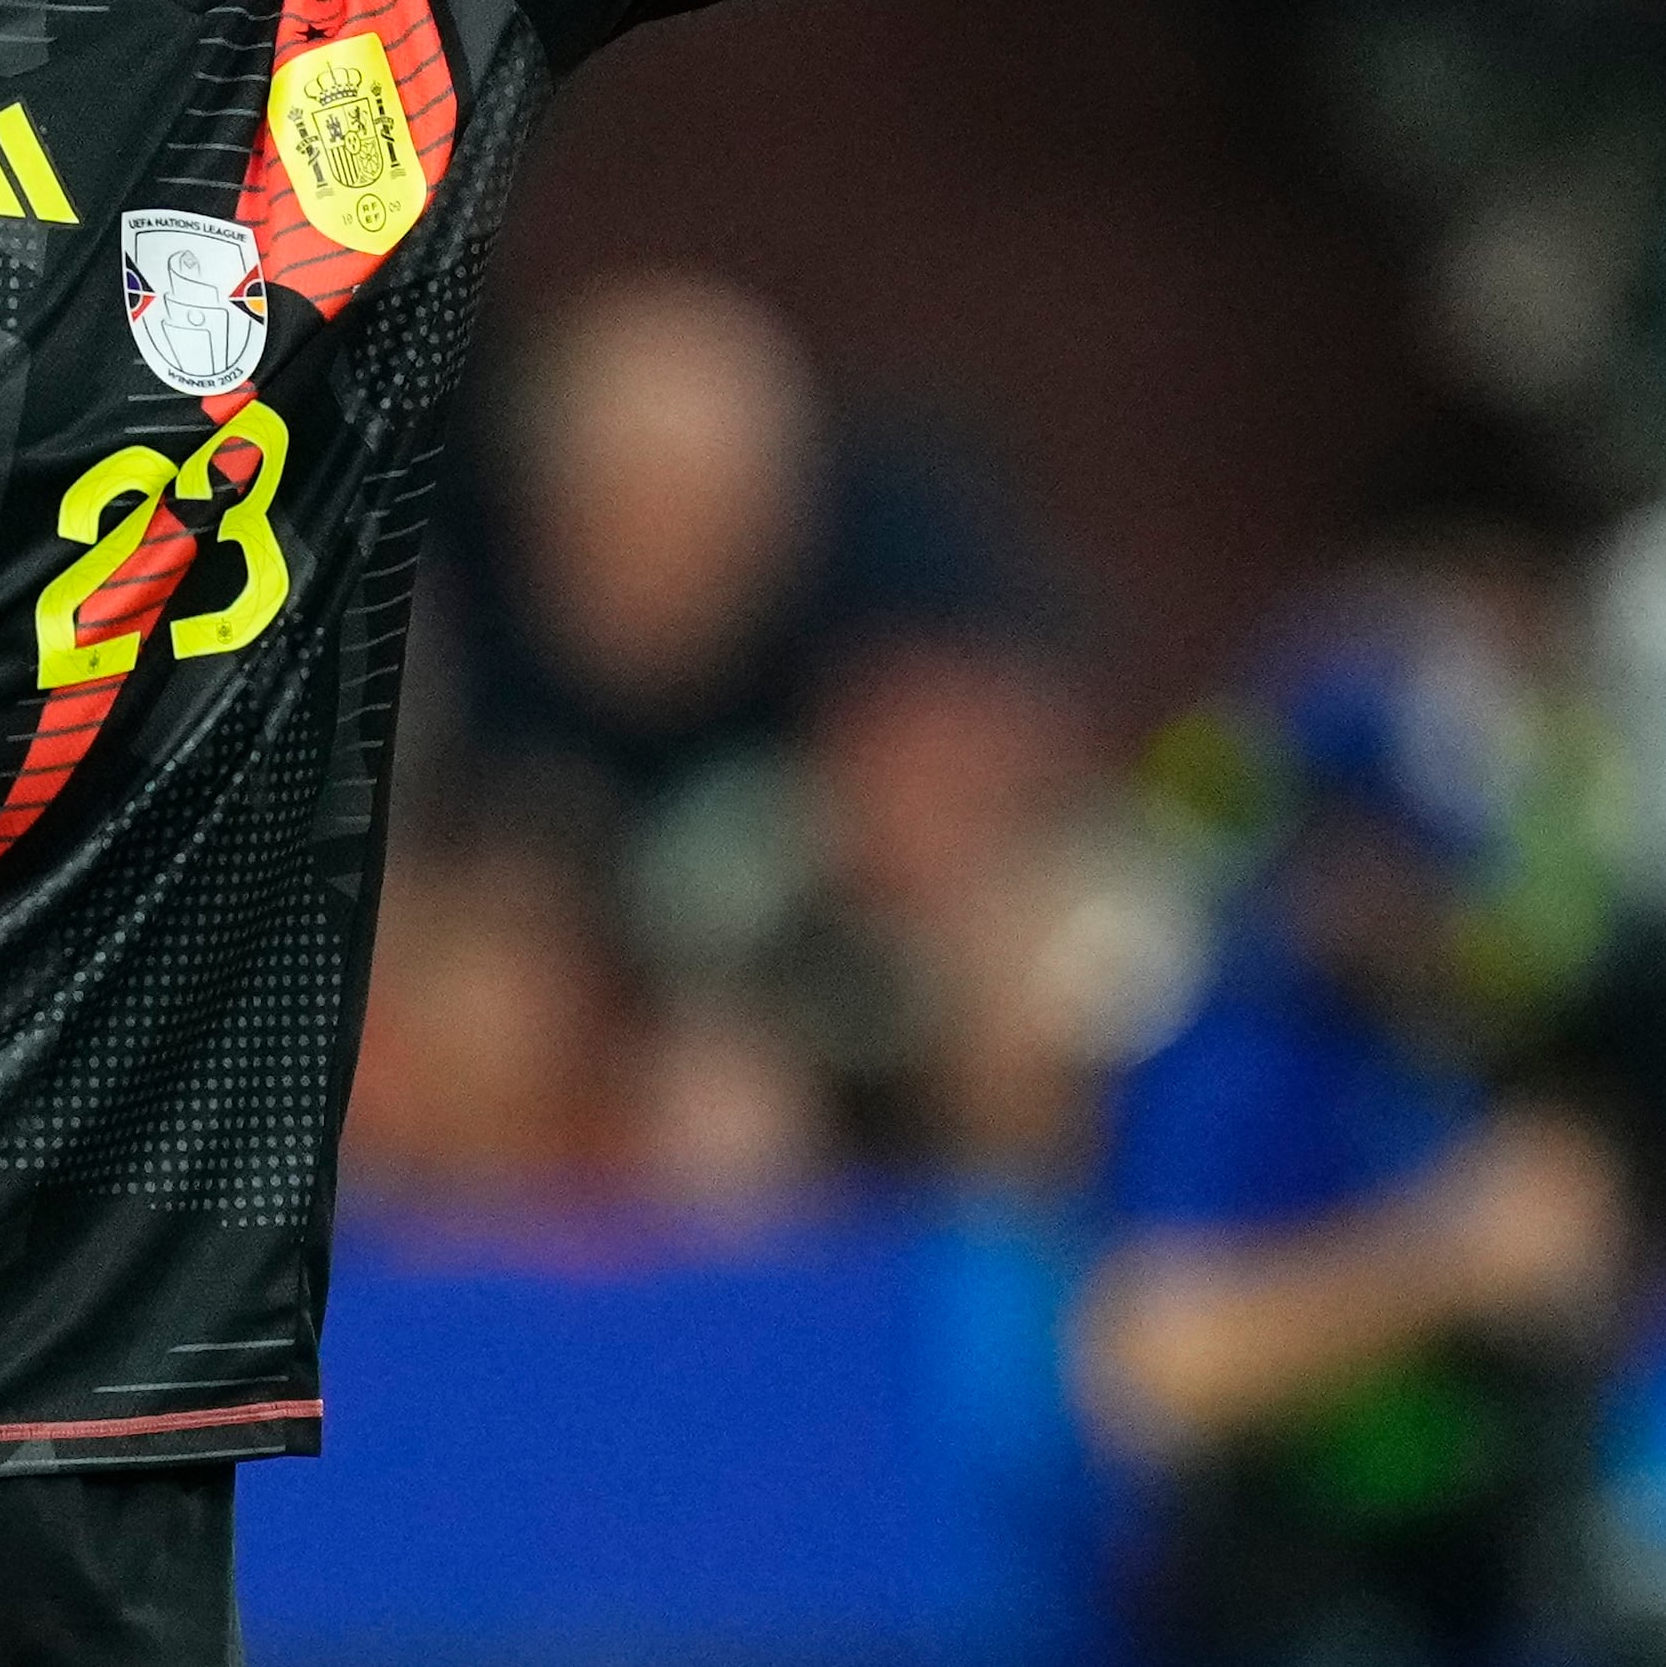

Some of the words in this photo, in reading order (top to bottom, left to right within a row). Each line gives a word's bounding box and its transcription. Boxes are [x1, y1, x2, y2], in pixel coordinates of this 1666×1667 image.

[128, 218, 152, 230] UEFA
[155, 217, 201, 232] NATIONS
[203, 222, 247, 243] LEAGUE
[168, 368, 216, 388] WINNER
[218, 367, 244, 386] 2023
[35, 399, 289, 690] 23
